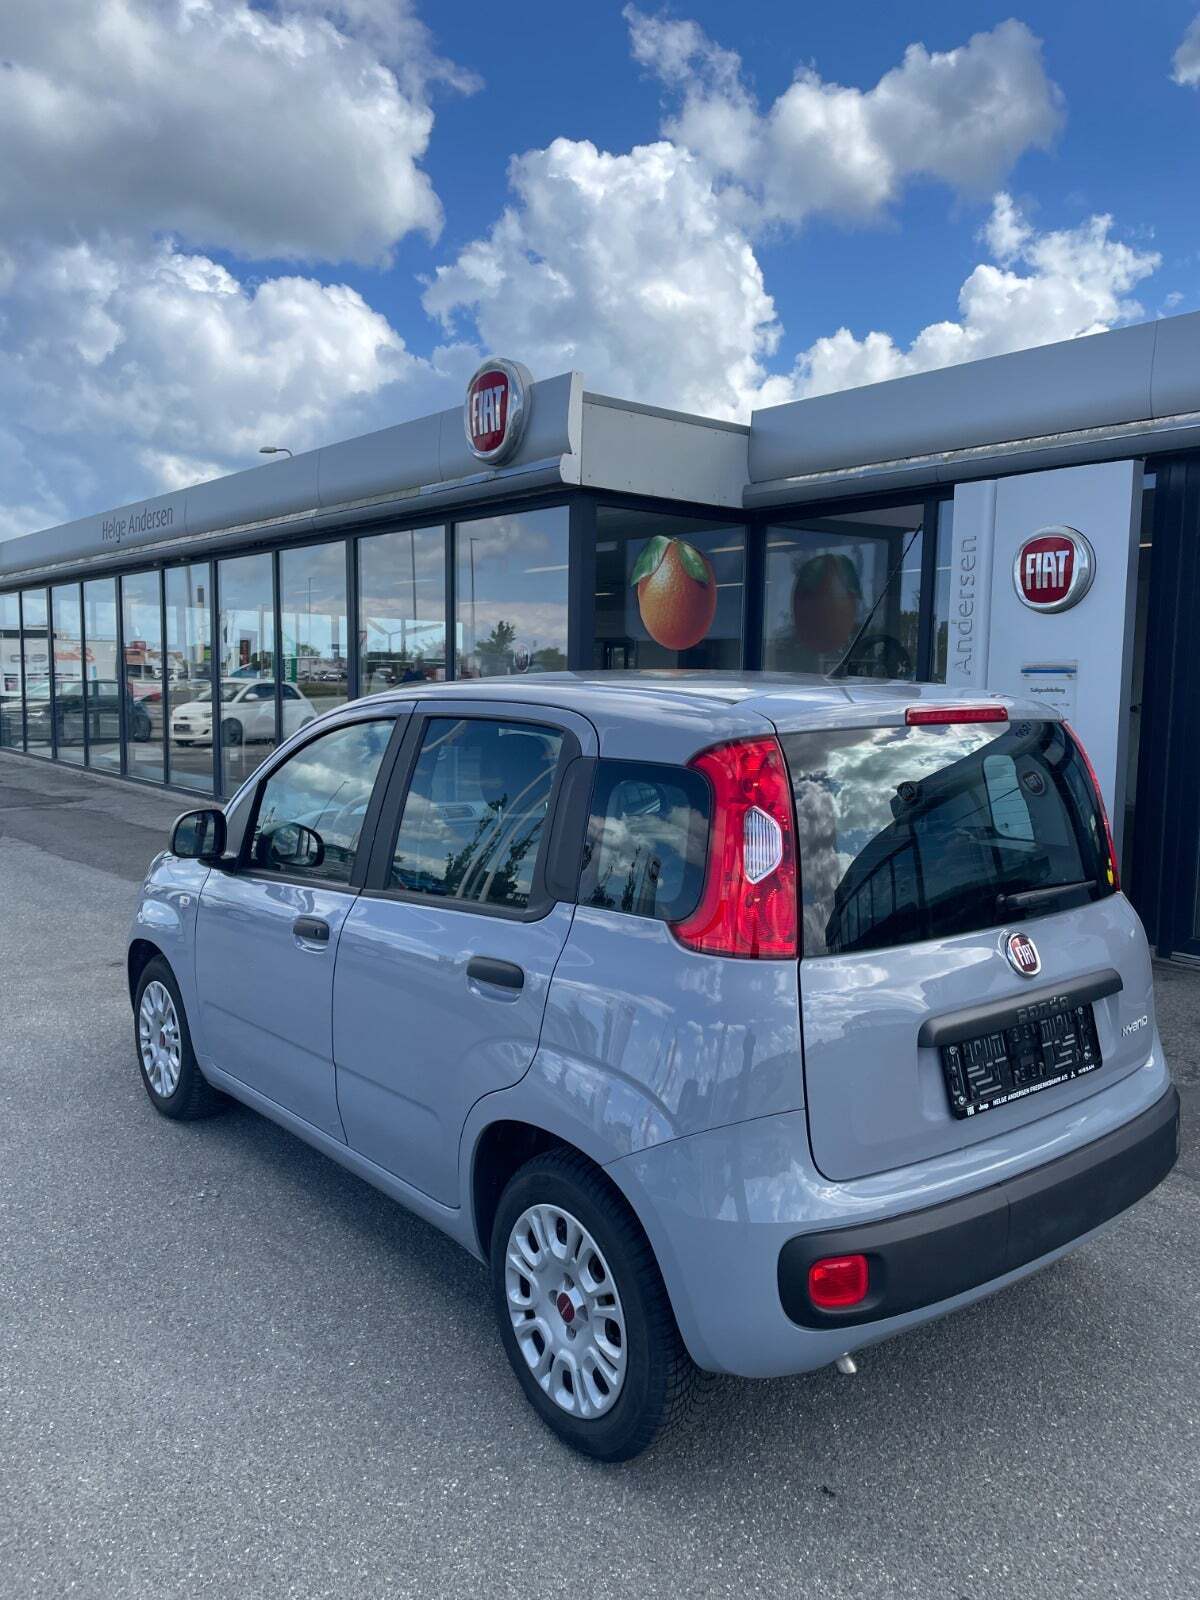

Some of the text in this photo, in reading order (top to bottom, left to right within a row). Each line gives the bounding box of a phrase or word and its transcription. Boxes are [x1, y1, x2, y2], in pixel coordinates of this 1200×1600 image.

[472, 384, 505, 437] FIAT
[102, 507, 174, 543] Helge Andersen
[1025, 549, 1070, 590] FIAT
[952, 535, 977, 676] Andersen
[1015, 943, 1036, 966] FIAT
